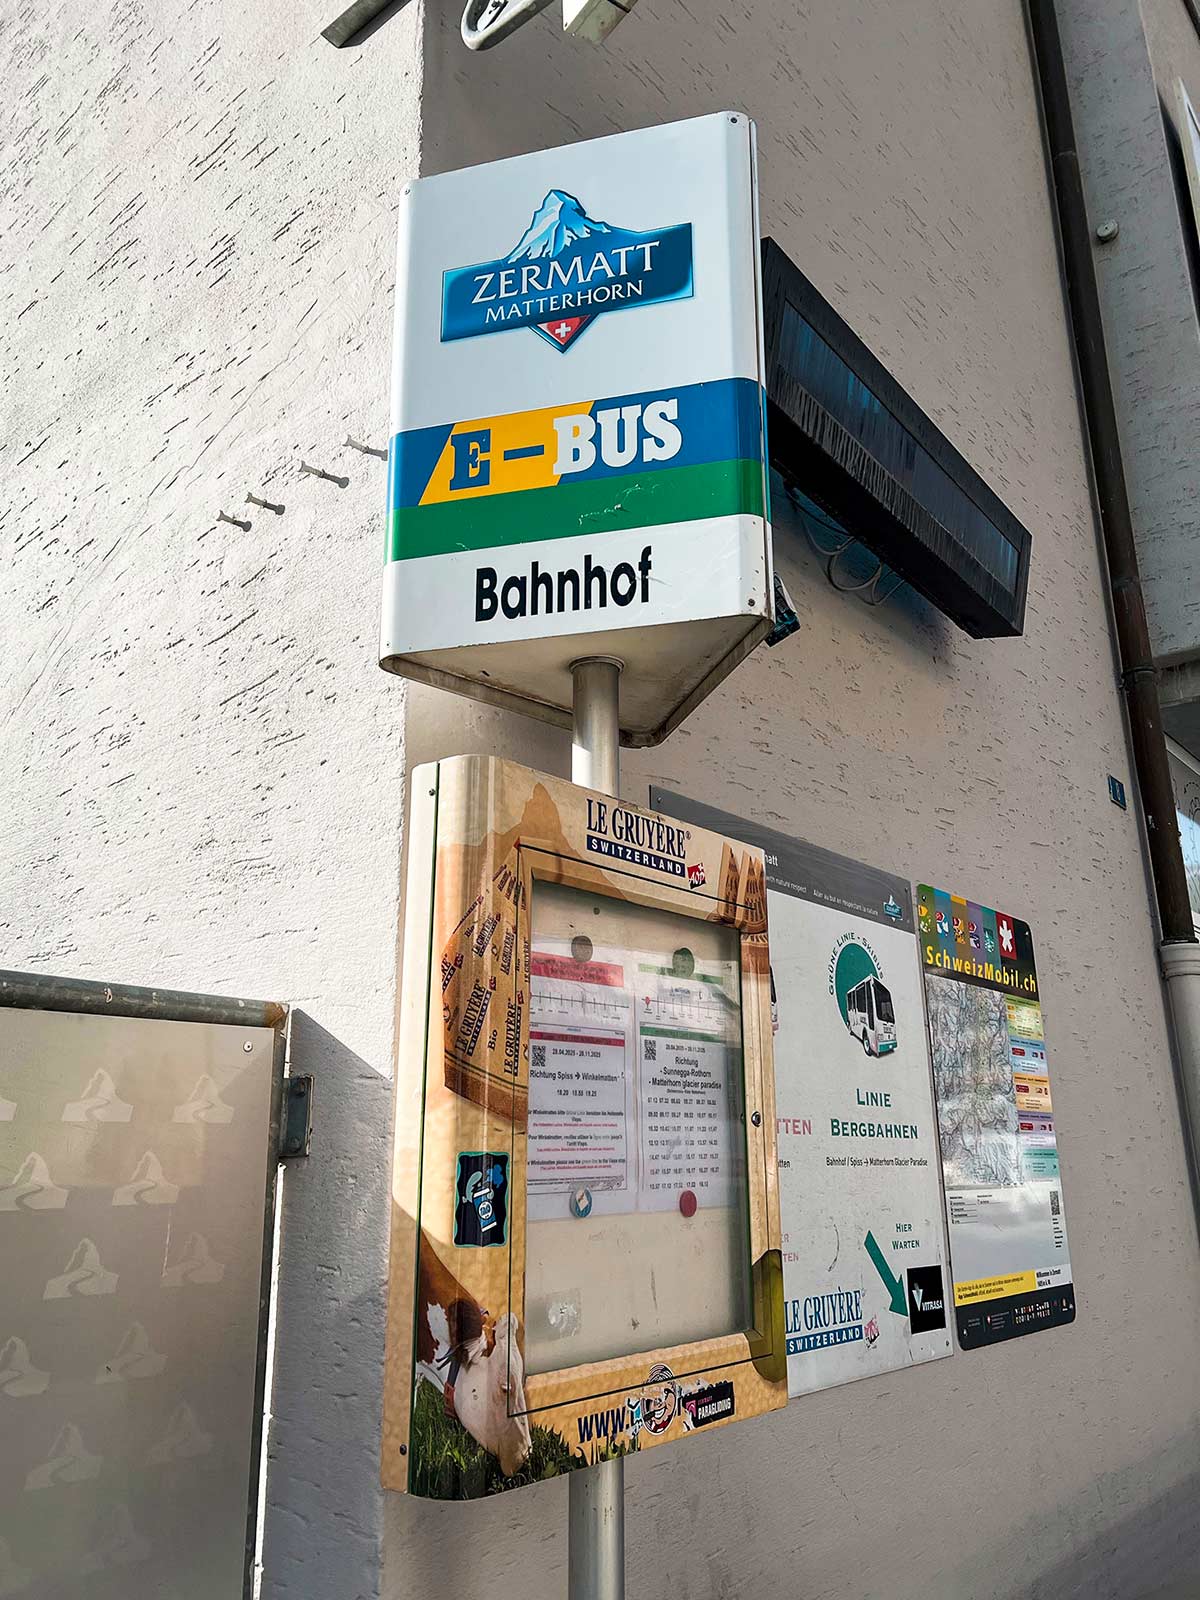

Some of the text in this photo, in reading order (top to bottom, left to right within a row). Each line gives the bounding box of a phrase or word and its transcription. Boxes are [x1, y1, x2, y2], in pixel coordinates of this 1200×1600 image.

[471, 240, 661, 304] ZERMATT
[484, 279, 644, 324] MATTERHORN
[474, 545, 653, 622] Bahnhof
[586, 798, 609, 836] LE
[591, 838, 682, 875] SWITZERLAND
[828, 947, 839, 996] GRÜNE
[836, 932, 856, 947] LINIE
[861, 937, 884, 980] SKIBUS
[926, 945, 1037, 993] SchweizMobil.ch
[488, 1029, 498, 1051] Bio
[663, 1066, 712, 1079] Sunnegga-Rothorn
[675, 1056, 699, 1068] Richtung
[529, 1069, 557, 1081] Richtung
[557, 1071, 574, 1081] Spiss
[652, 1077, 682, 1087] Matterhorn
[682, 1079, 700, 1090] glacier
[700, 1081, 722, 1091] paradise
[826, 1156, 847, 1167] Bahnhof
[850, 1157, 863, 1168] Spiss
[869, 1157, 894, 1167] Matterhorn
[894, 1157, 910, 1167] Glacier
[909, 1158, 928, 1167] Paradise
[785, 1286, 863, 1334] LE GRUYÈRE
[922, 1300, 943, 1312] VITRASA
[789, 1329, 861, 1353] SWITZERLAND
[698, 1397, 732, 1421] PARAGLIDING
